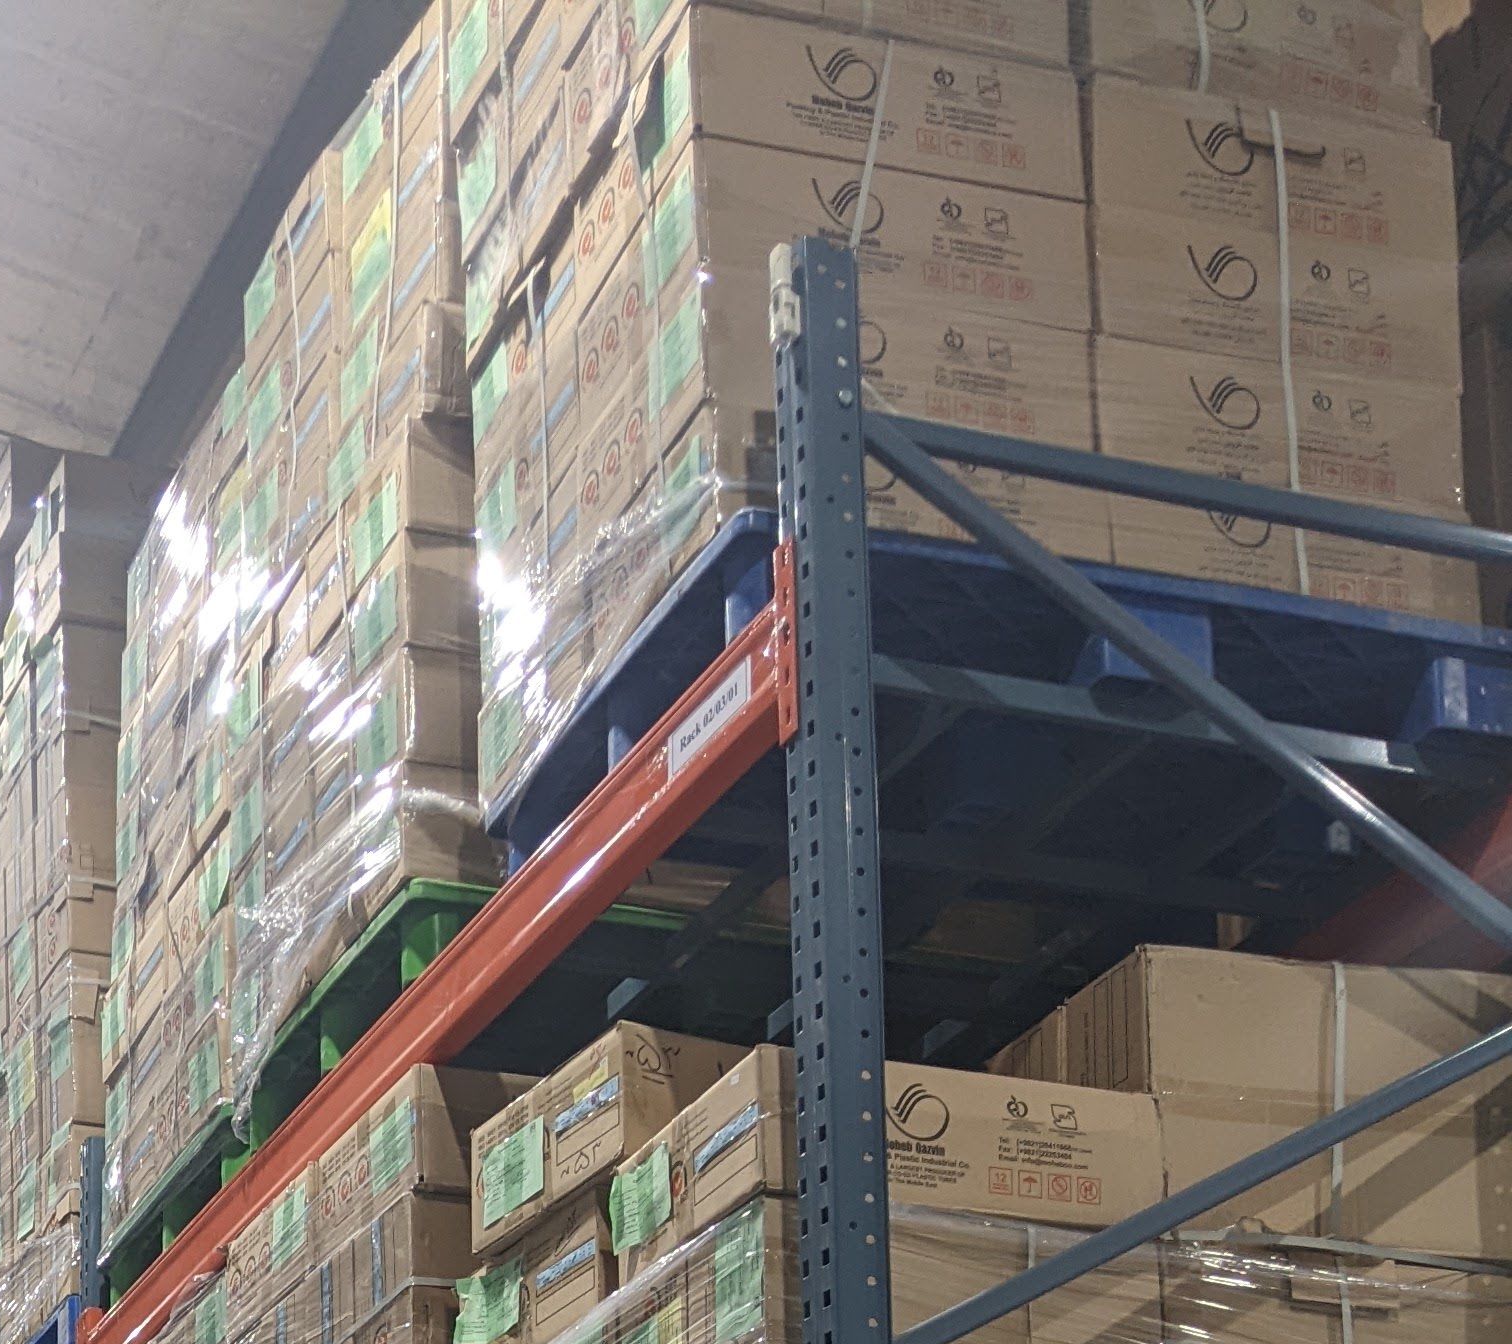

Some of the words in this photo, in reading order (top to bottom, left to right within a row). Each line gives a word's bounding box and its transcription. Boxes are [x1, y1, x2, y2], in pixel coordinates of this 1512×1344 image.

[679, 722, 702, 752] Rack
[703, 681, 738, 728] 02/03/01
[887, 1138, 913, 1151] oheb
